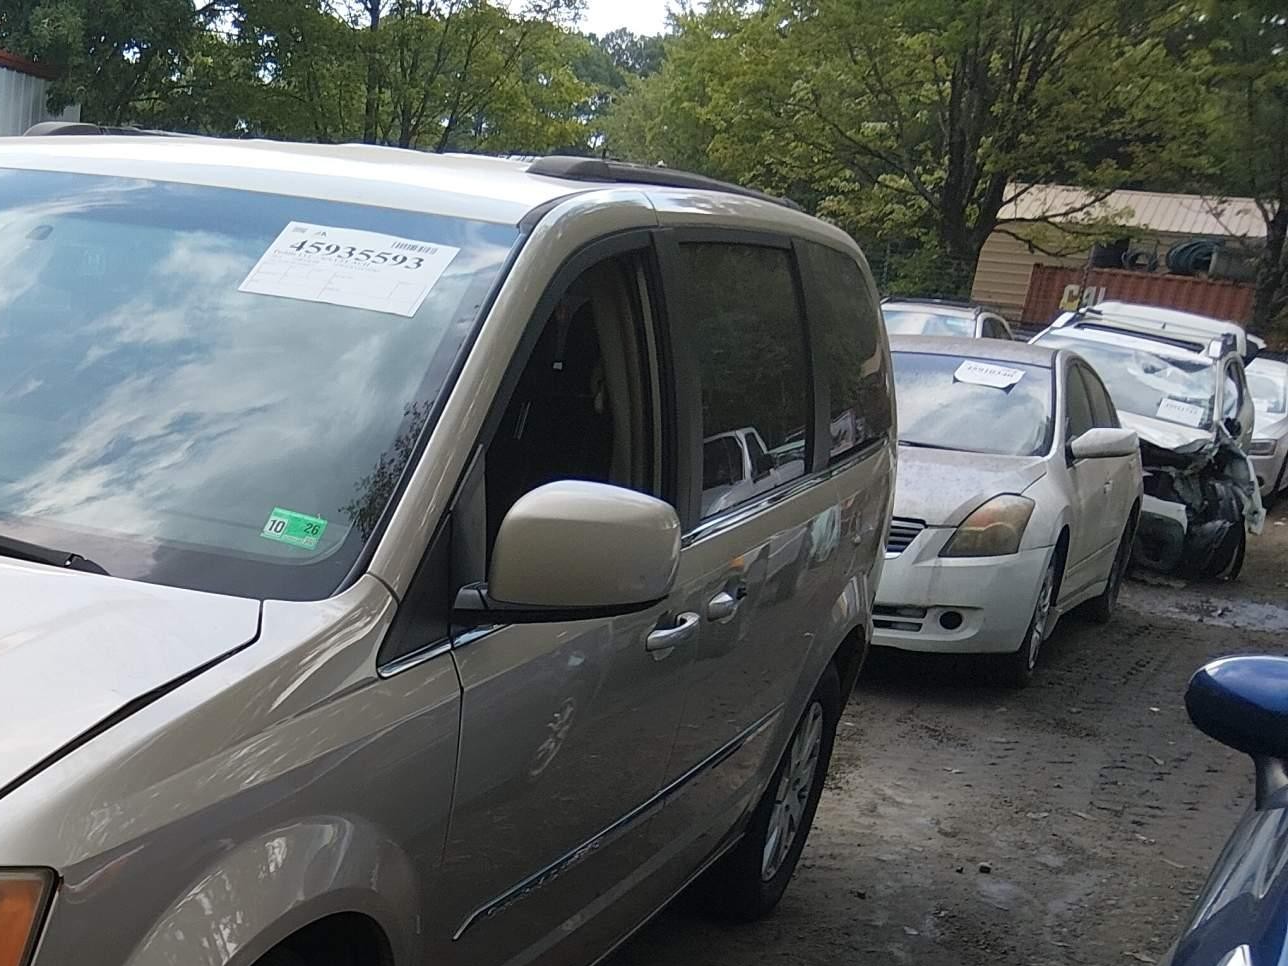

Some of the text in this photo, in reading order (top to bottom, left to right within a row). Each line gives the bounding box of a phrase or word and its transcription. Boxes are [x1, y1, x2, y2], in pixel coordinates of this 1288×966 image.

[289, 239, 425, 270] 45935593
[268, 519, 320, 536] 10 26
